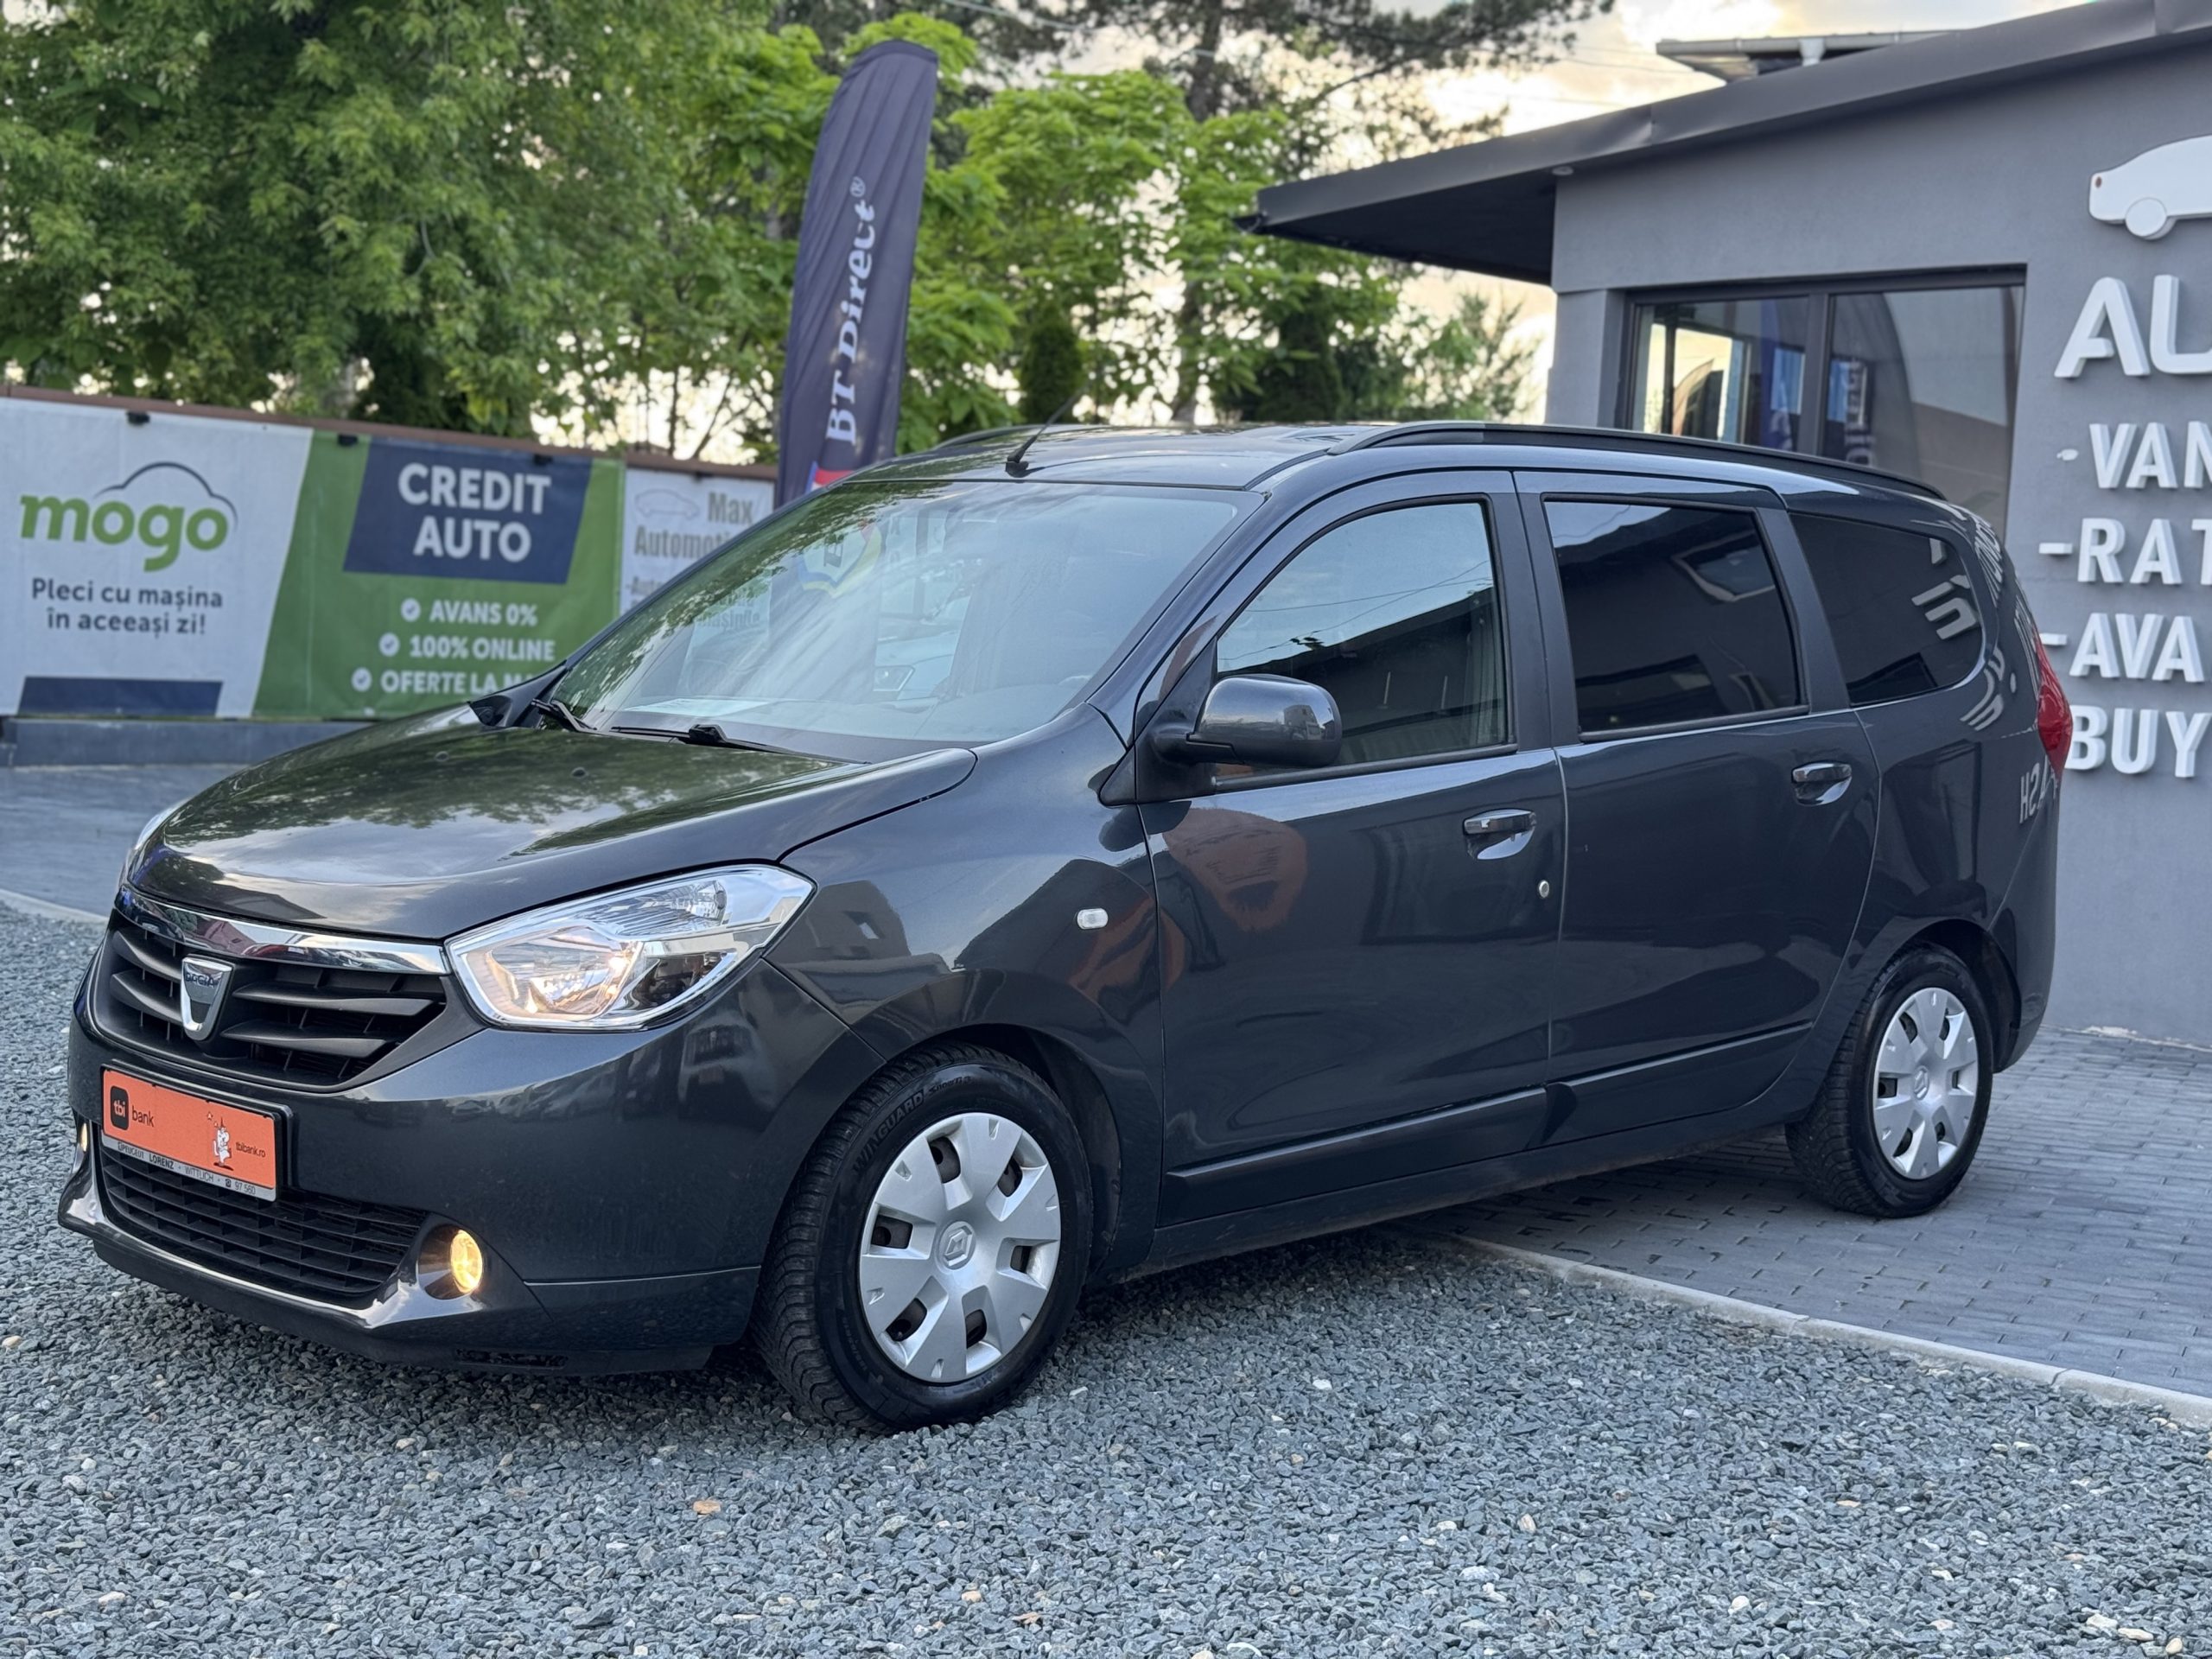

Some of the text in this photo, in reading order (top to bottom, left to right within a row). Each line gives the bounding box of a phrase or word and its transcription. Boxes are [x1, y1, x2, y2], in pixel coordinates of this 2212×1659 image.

[824, 370, 857, 446] BT
[398, 463, 551, 514] CREDIT
[708, 492, 753, 525] Max
[20, 495, 229, 573] mogo
[413, 517, 532, 563] AUTO
[32, 578, 223, 613] Pleci cu mașina
[47, 607, 206, 639] în aceeași zi!
[429, 600, 537, 626] AVANS 0%
[409, 634, 556, 662] 100% ONLINE
[380, 669, 467, 695] OFERTE
[470, 671, 497, 695] LA
[2063, 704, 2212, 778] BUY
[112, 1100, 155, 1128] tbi bank
[235, 1141, 266, 1158] tbibank.ro
[149, 1153, 175, 1169] LORENZ
[184, 1166, 214, 1183] WITTLICH
